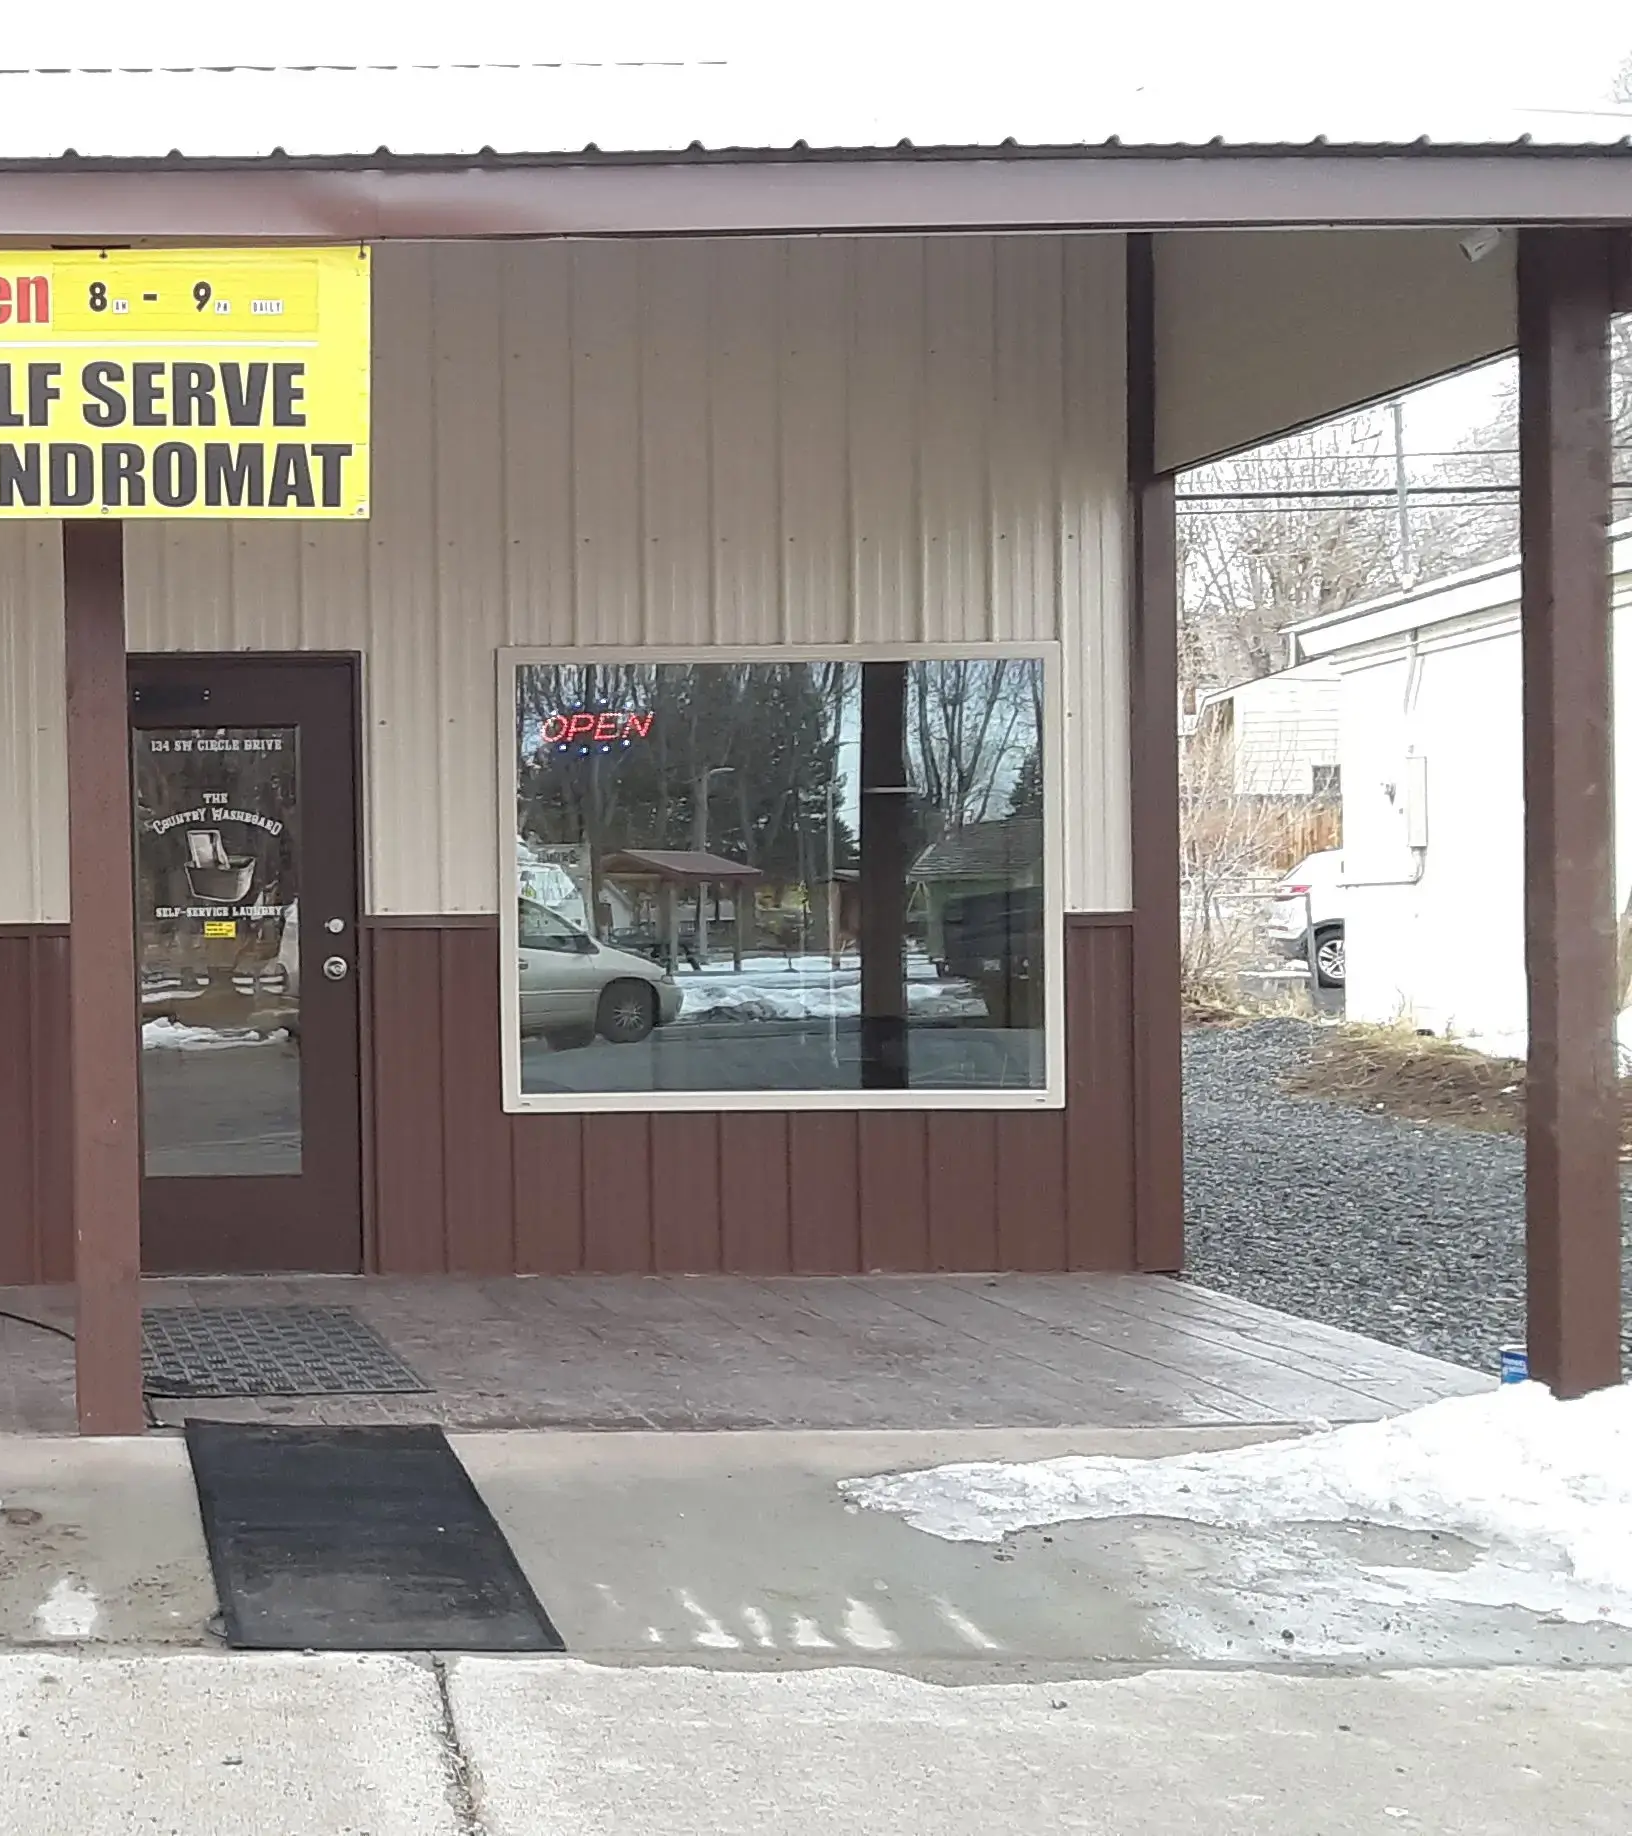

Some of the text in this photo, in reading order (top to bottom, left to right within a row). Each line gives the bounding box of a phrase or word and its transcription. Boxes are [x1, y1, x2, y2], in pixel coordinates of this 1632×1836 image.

[89, 282, 108, 312] 8
[143, 293, 157, 301] -
[193, 281, 212, 312] 9
[253, 302, 281, 313] DAILY
[81, 362, 307, 428] SERVE
[540, 711, 655, 743] OPEN
[151, 739, 282, 752] 134 SW CIRCLE DRIVE
[203, 793, 228, 804] THE
[152, 807, 283, 836] COUNTRY WASHBOARD
[155, 905, 282, 918] SELF-SERVICE LAUNDRY
